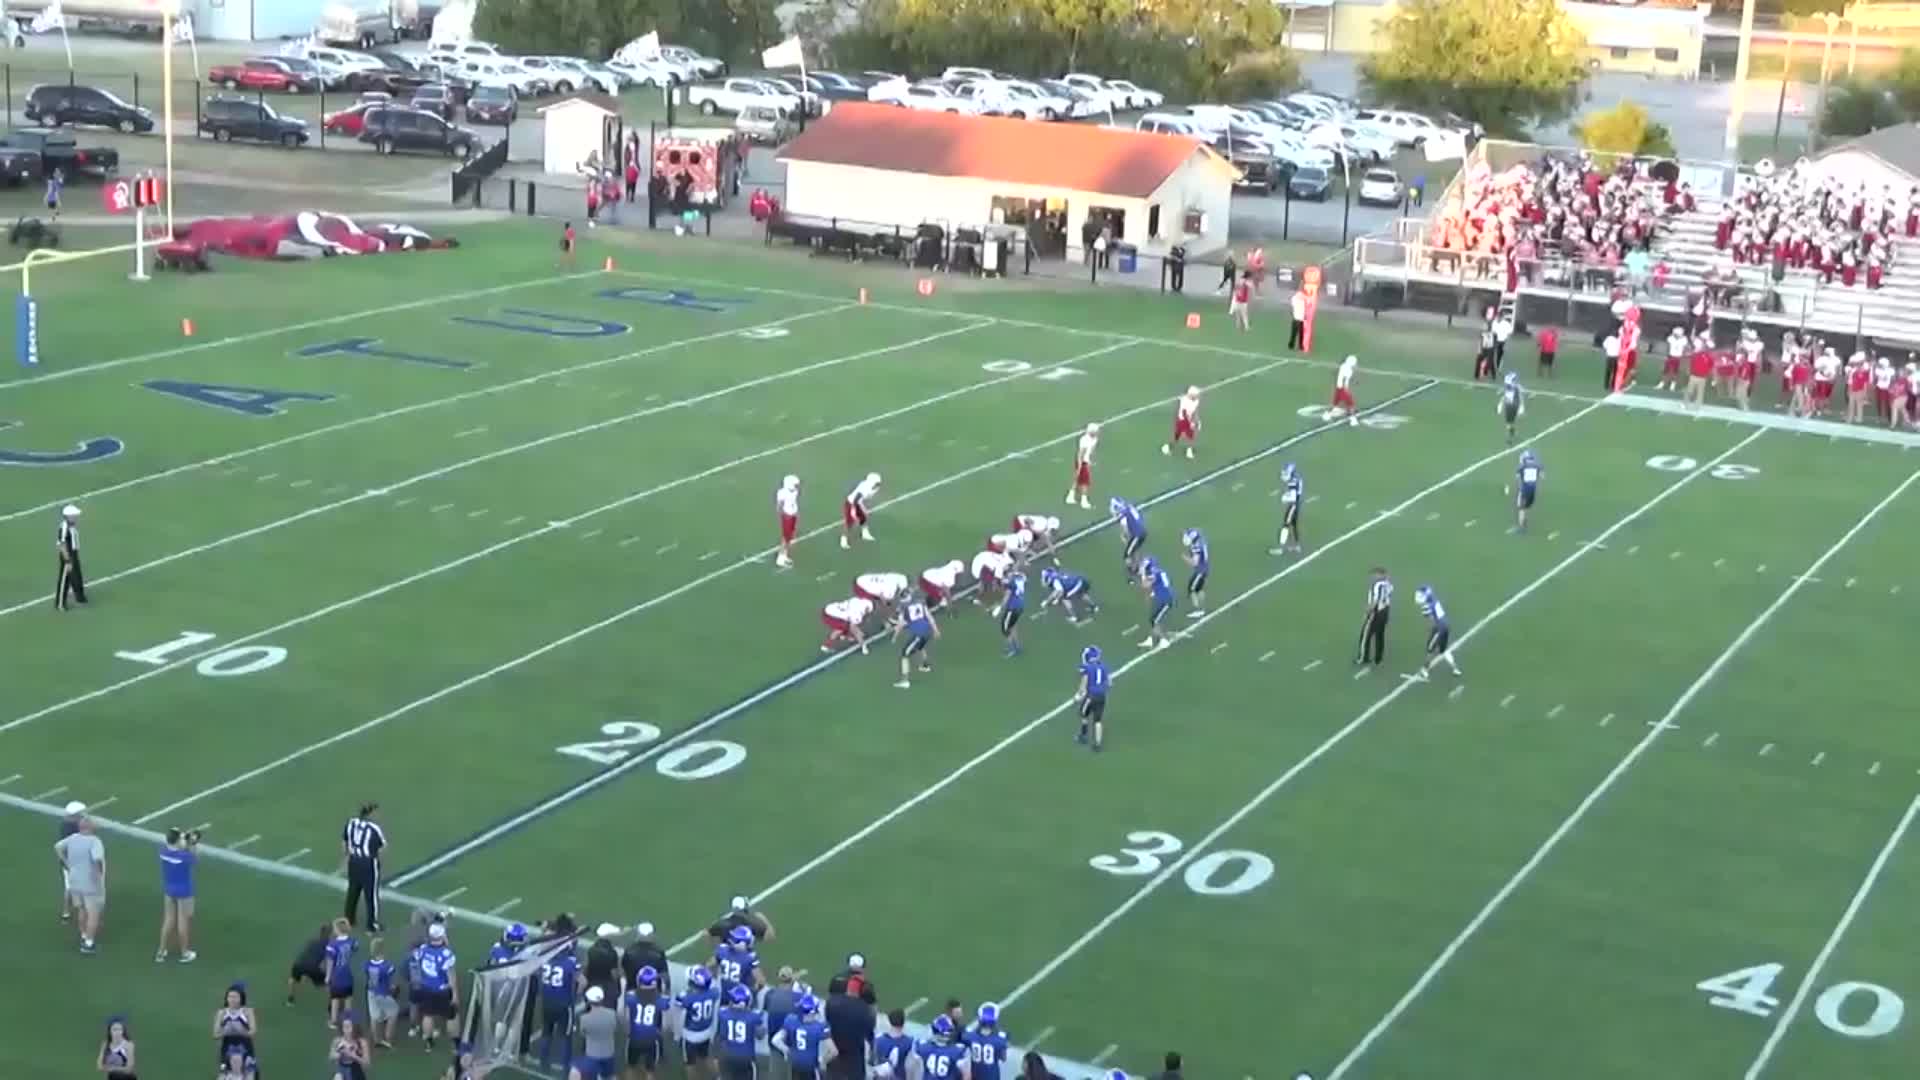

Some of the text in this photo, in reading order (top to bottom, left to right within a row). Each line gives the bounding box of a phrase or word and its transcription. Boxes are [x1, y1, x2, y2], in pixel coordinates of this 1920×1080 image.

[114, 630, 288, 677] 10
[556, 721, 747, 780] 20
[1089, 831, 1275, 895] 30
[541, 965, 564, 987] 22
[720, 959, 741, 982] 32
[692, 999, 712, 1021] 30
[1696, 962, 1905, 1038] 40
[635, 1003, 656, 1026] 18
[727, 1019, 747, 1044] 19
[796, 1029, 807, 1049] 5
[925, 1053, 949, 1077] 46
